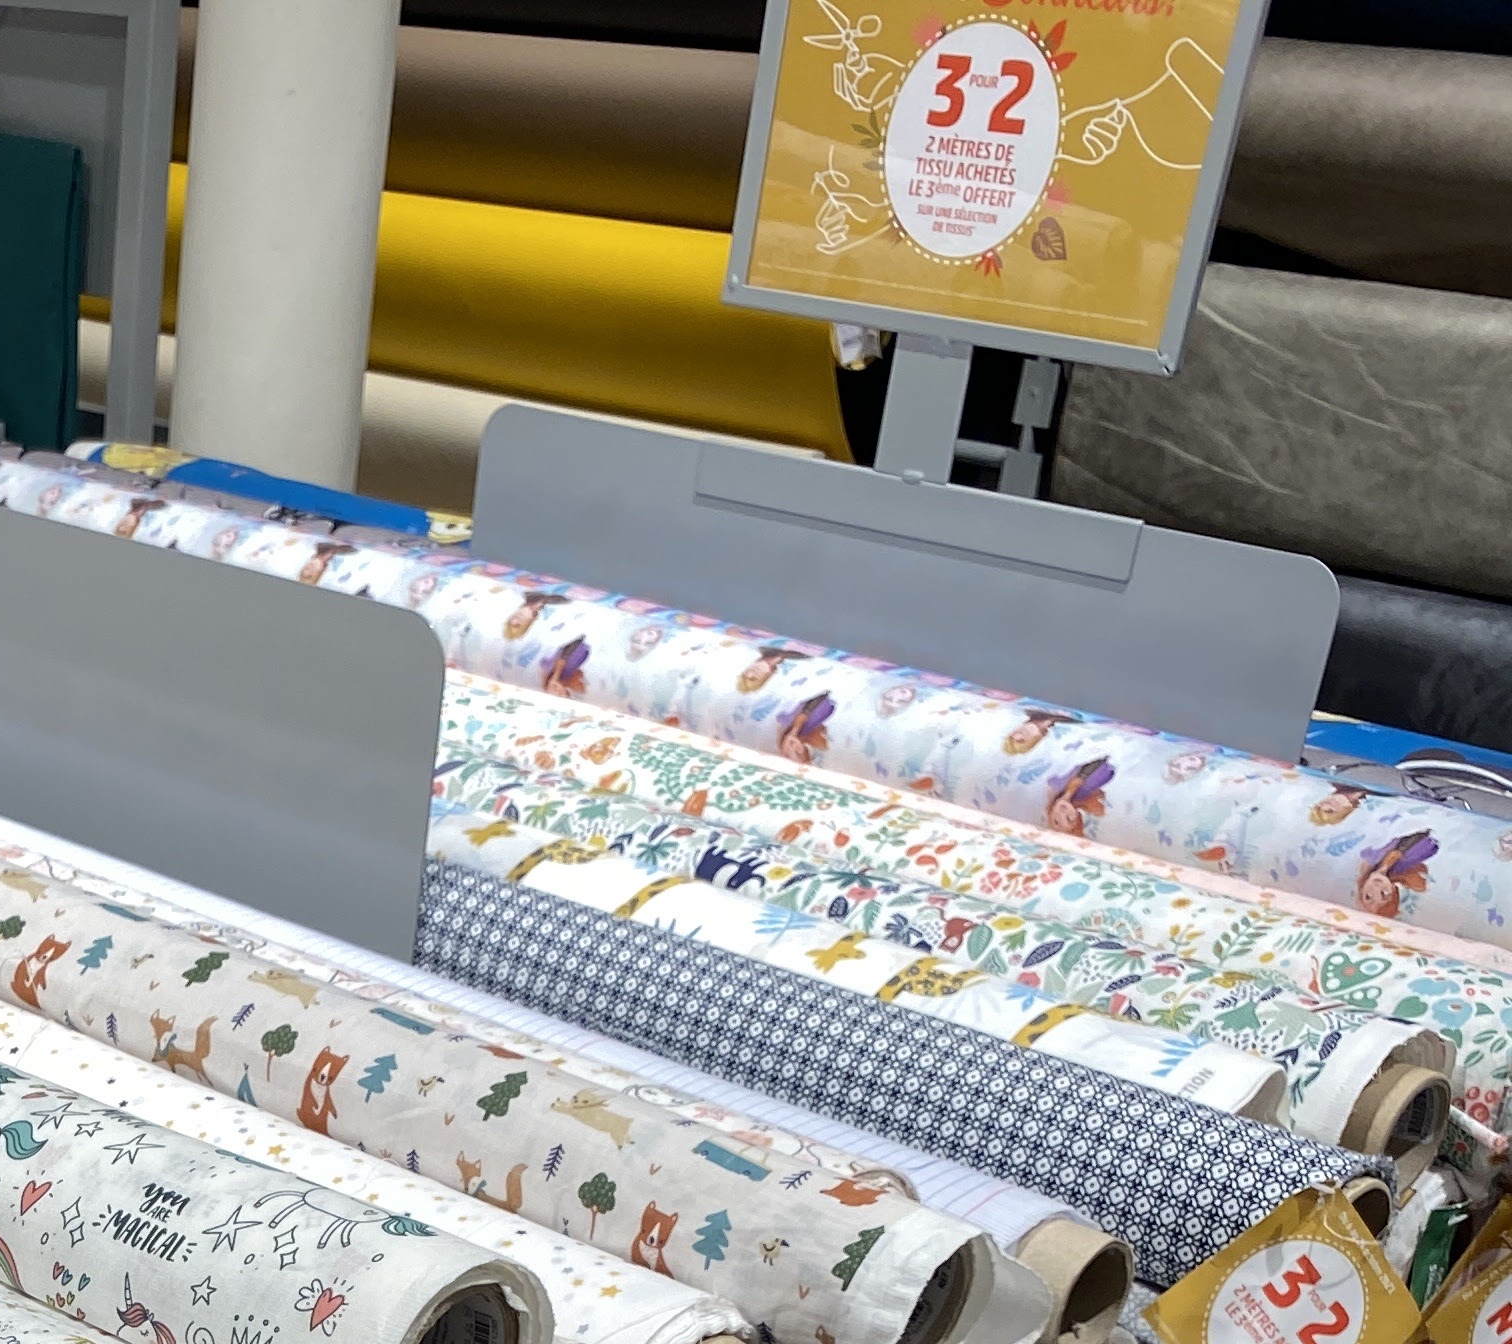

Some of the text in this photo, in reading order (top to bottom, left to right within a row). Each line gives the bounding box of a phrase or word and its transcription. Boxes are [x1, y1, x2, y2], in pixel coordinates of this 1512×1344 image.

[926, 54, 1034, 135] 3 POUR 2
[925, 134, 1015, 162] 2 MÈTRES DE
[915, 157, 1016, 186] TISSU ACHETÉS
[909, 178, 1017, 208] LE 3ème OFFERT
[139, 1183, 191, 1215] you
[146, 1206, 173, 1223] ARE
[102, 1209, 186, 1262] MAGICAL
[1261, 1254, 1322, 1308] 3
[1224, 1303, 1236, 1320] LE
[1233, 1284, 1247, 1297] 2
[1242, 1292, 1280, 1339] MÈTRES
